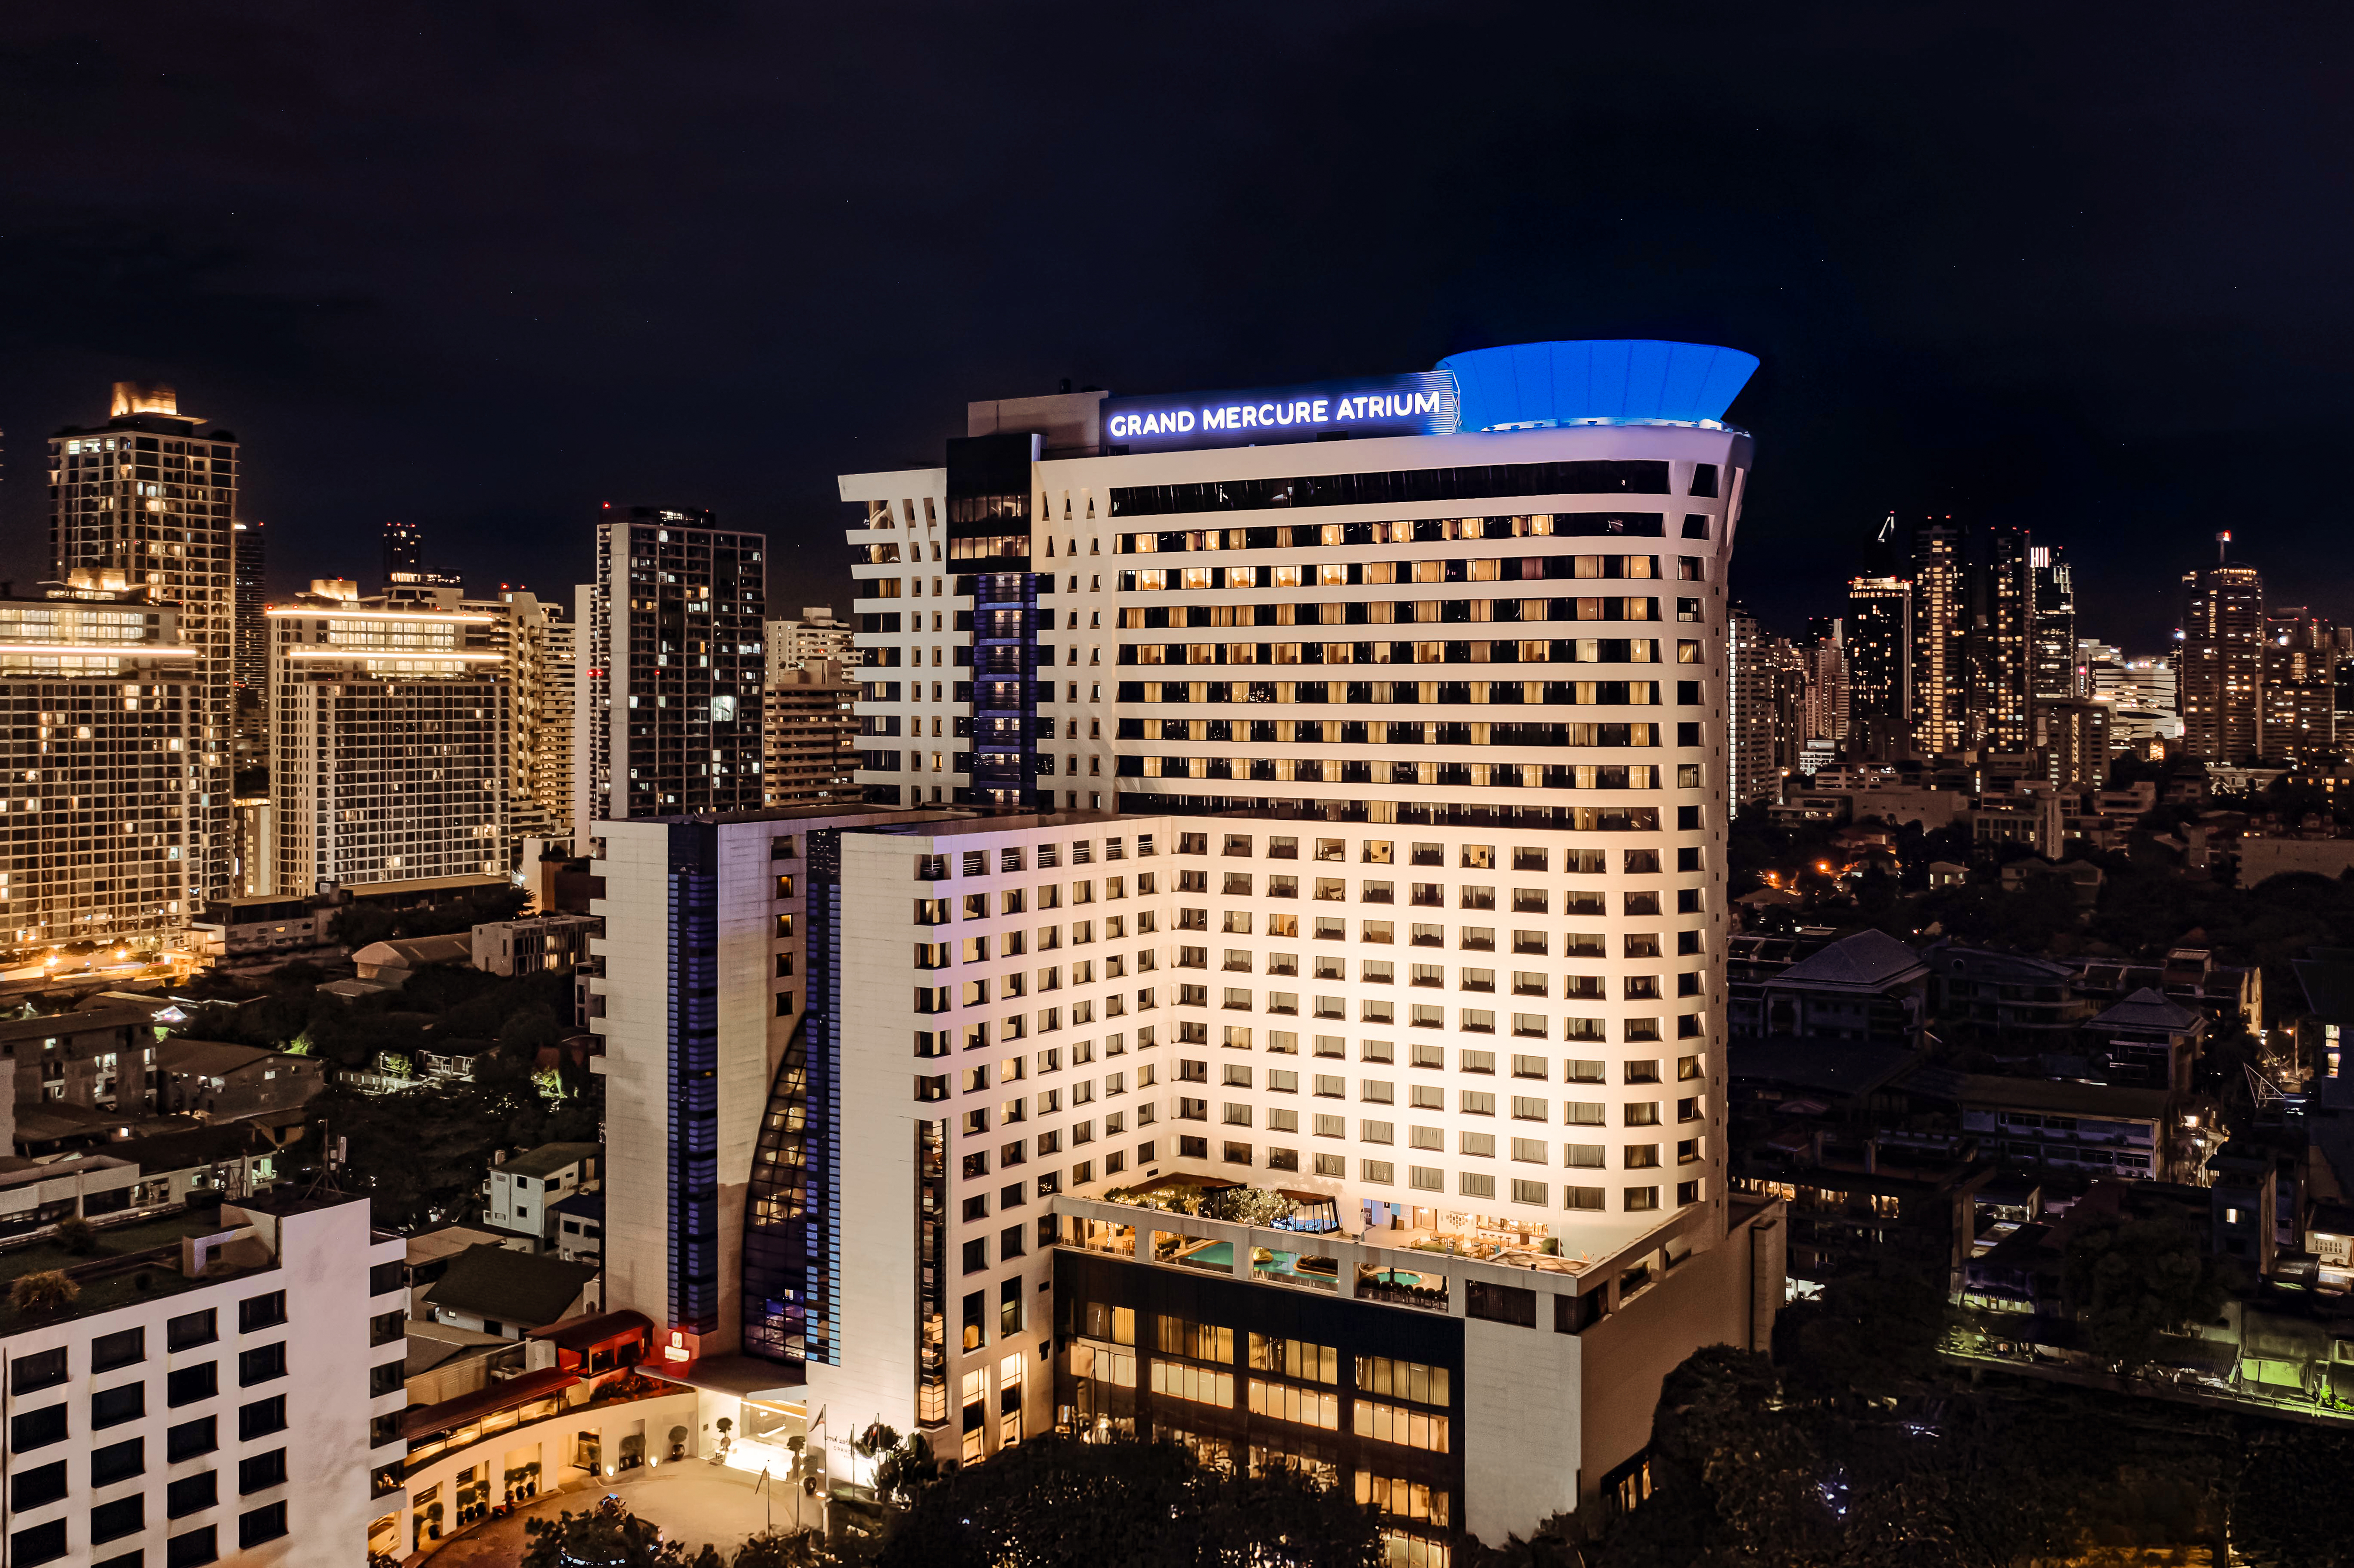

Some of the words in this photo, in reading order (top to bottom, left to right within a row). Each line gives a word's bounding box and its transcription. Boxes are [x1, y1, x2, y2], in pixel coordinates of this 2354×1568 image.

[1110, 411, 1196, 437] GRAND
[1203, 400, 1329, 430] MERCURE
[1336, 391, 1440, 421] ATRIUM
